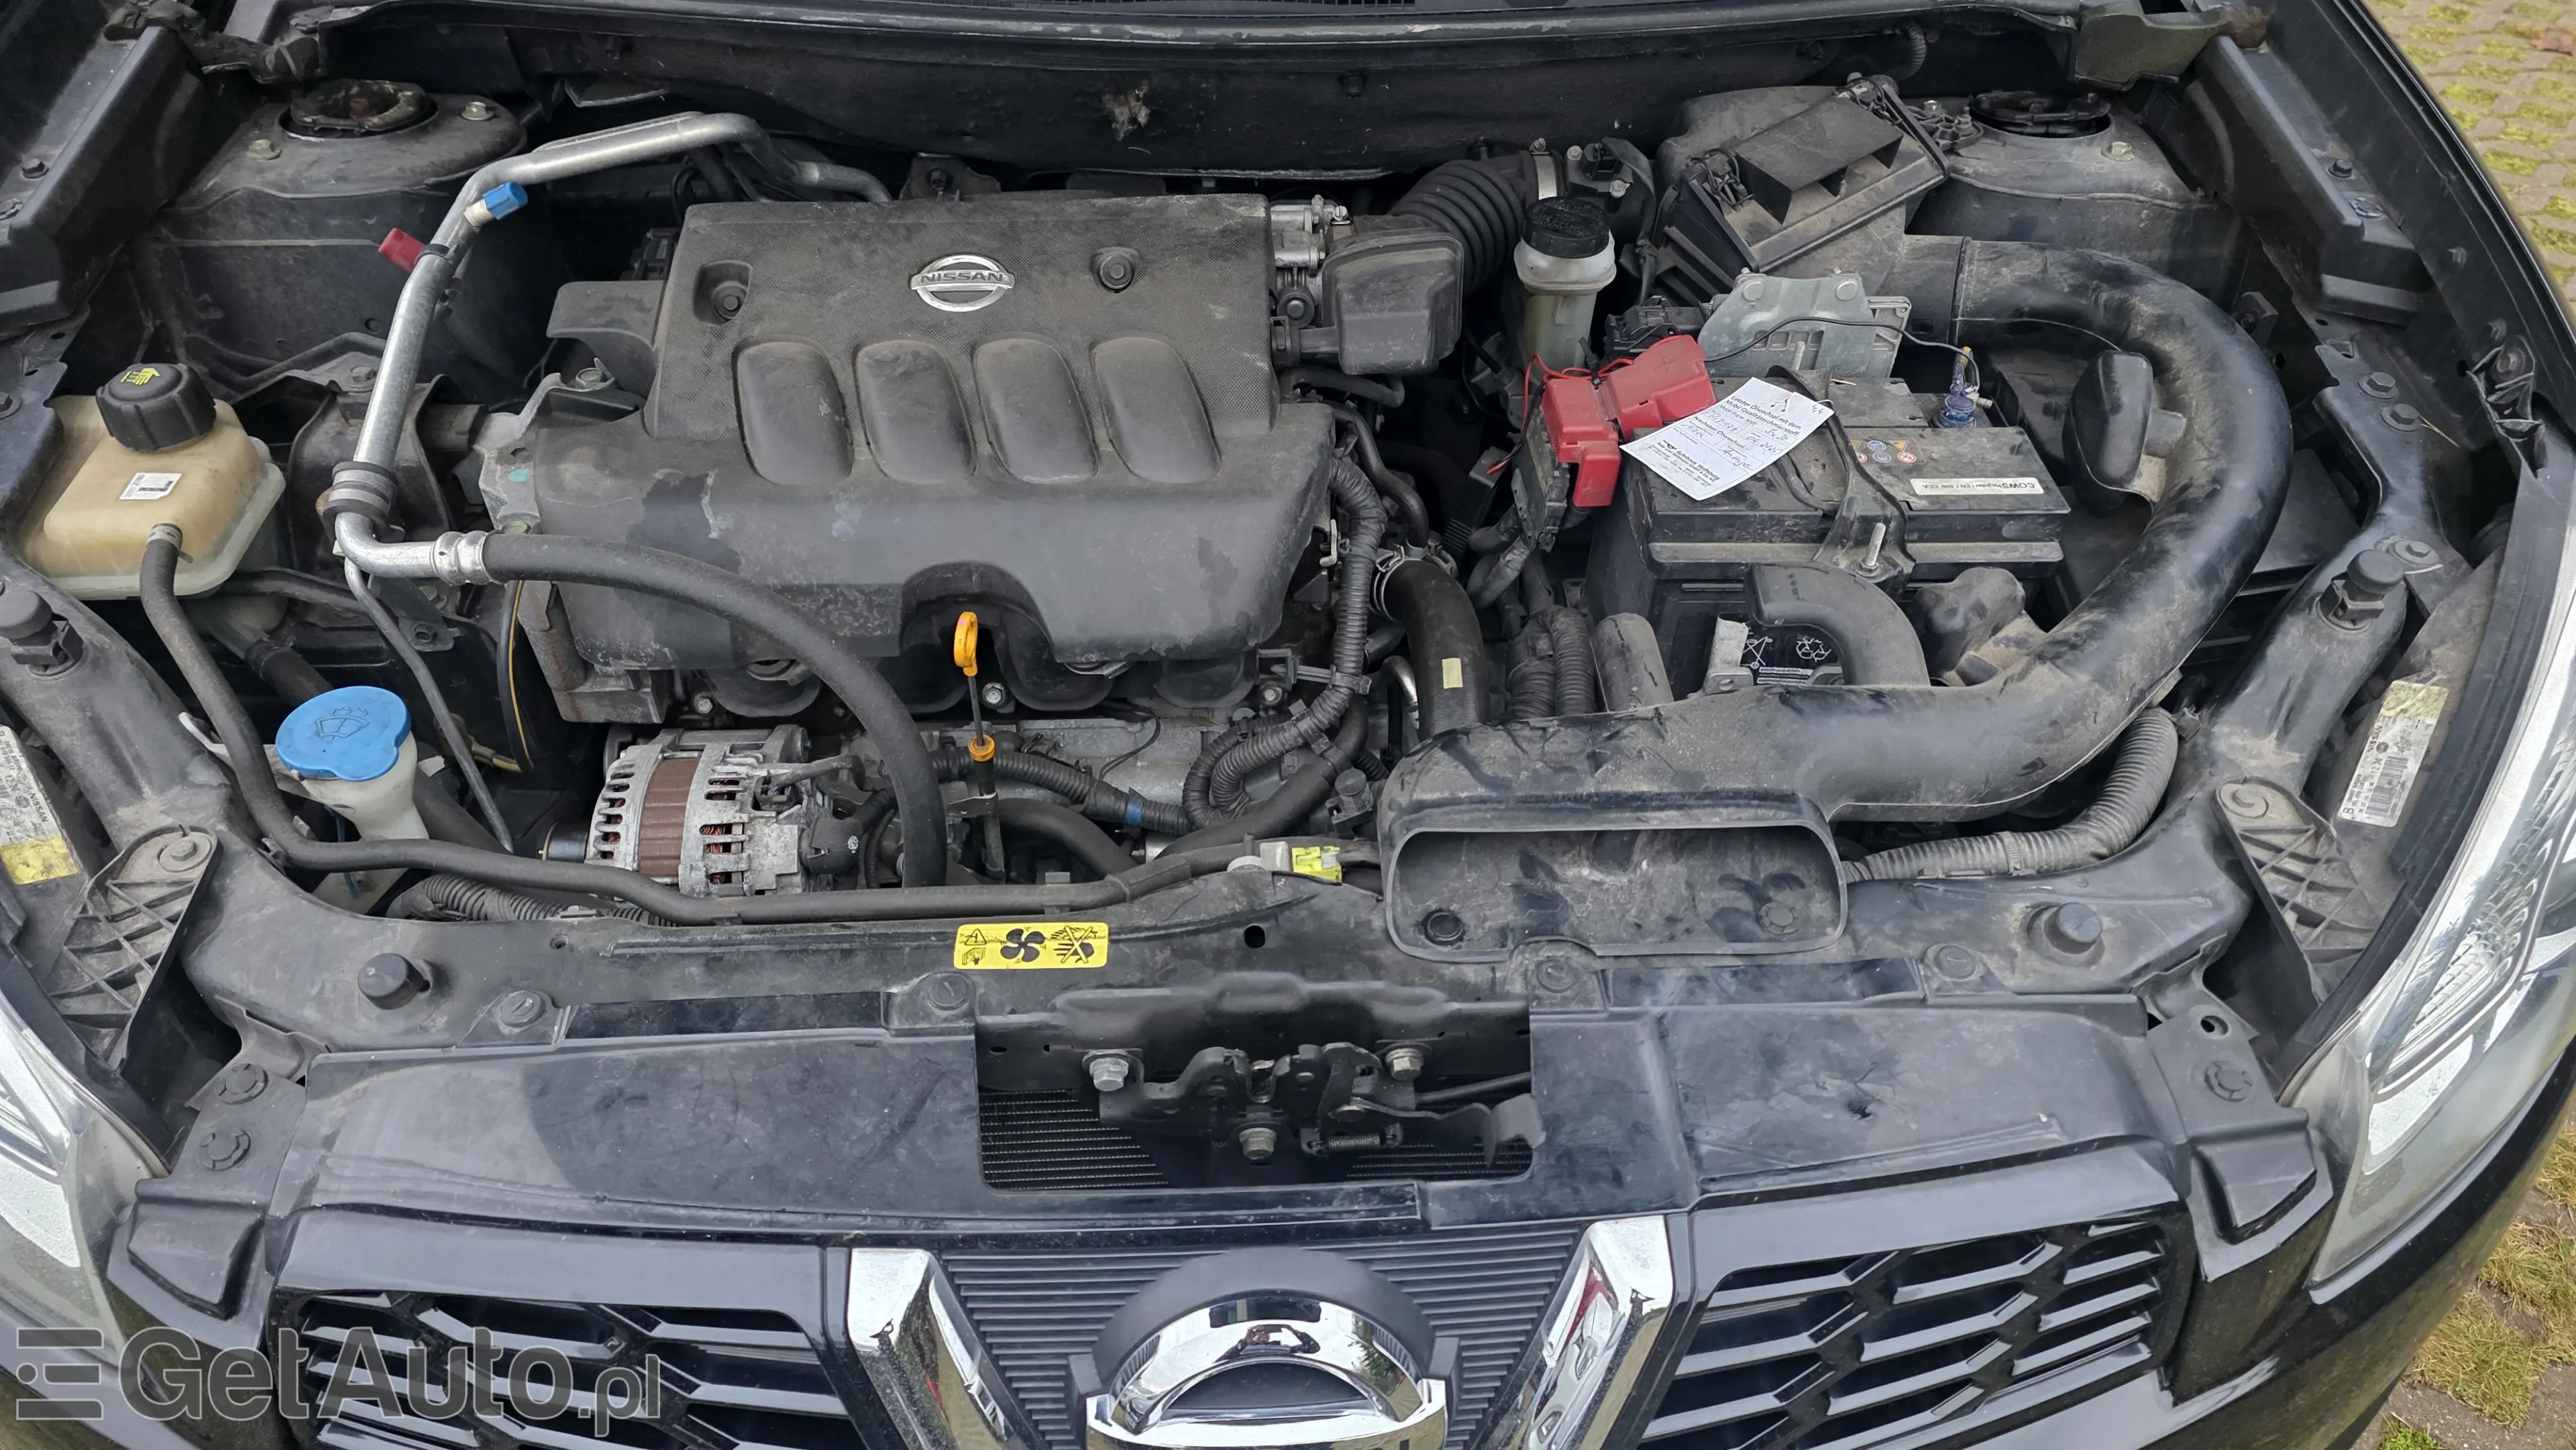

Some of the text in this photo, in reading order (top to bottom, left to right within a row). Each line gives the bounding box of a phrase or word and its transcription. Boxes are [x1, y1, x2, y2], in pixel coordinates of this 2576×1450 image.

[920, 272, 1004, 284] NISSAN
[1725, 399, 1742, 410] Mobil
[1731, 395, 1801, 430] Letzter Ölwechsel mit dem
[1693, 416, 1717, 431] Nächster
[2367, 726, 2383, 752] NISSAN
[29, 793, 49, 823] NISSAN
